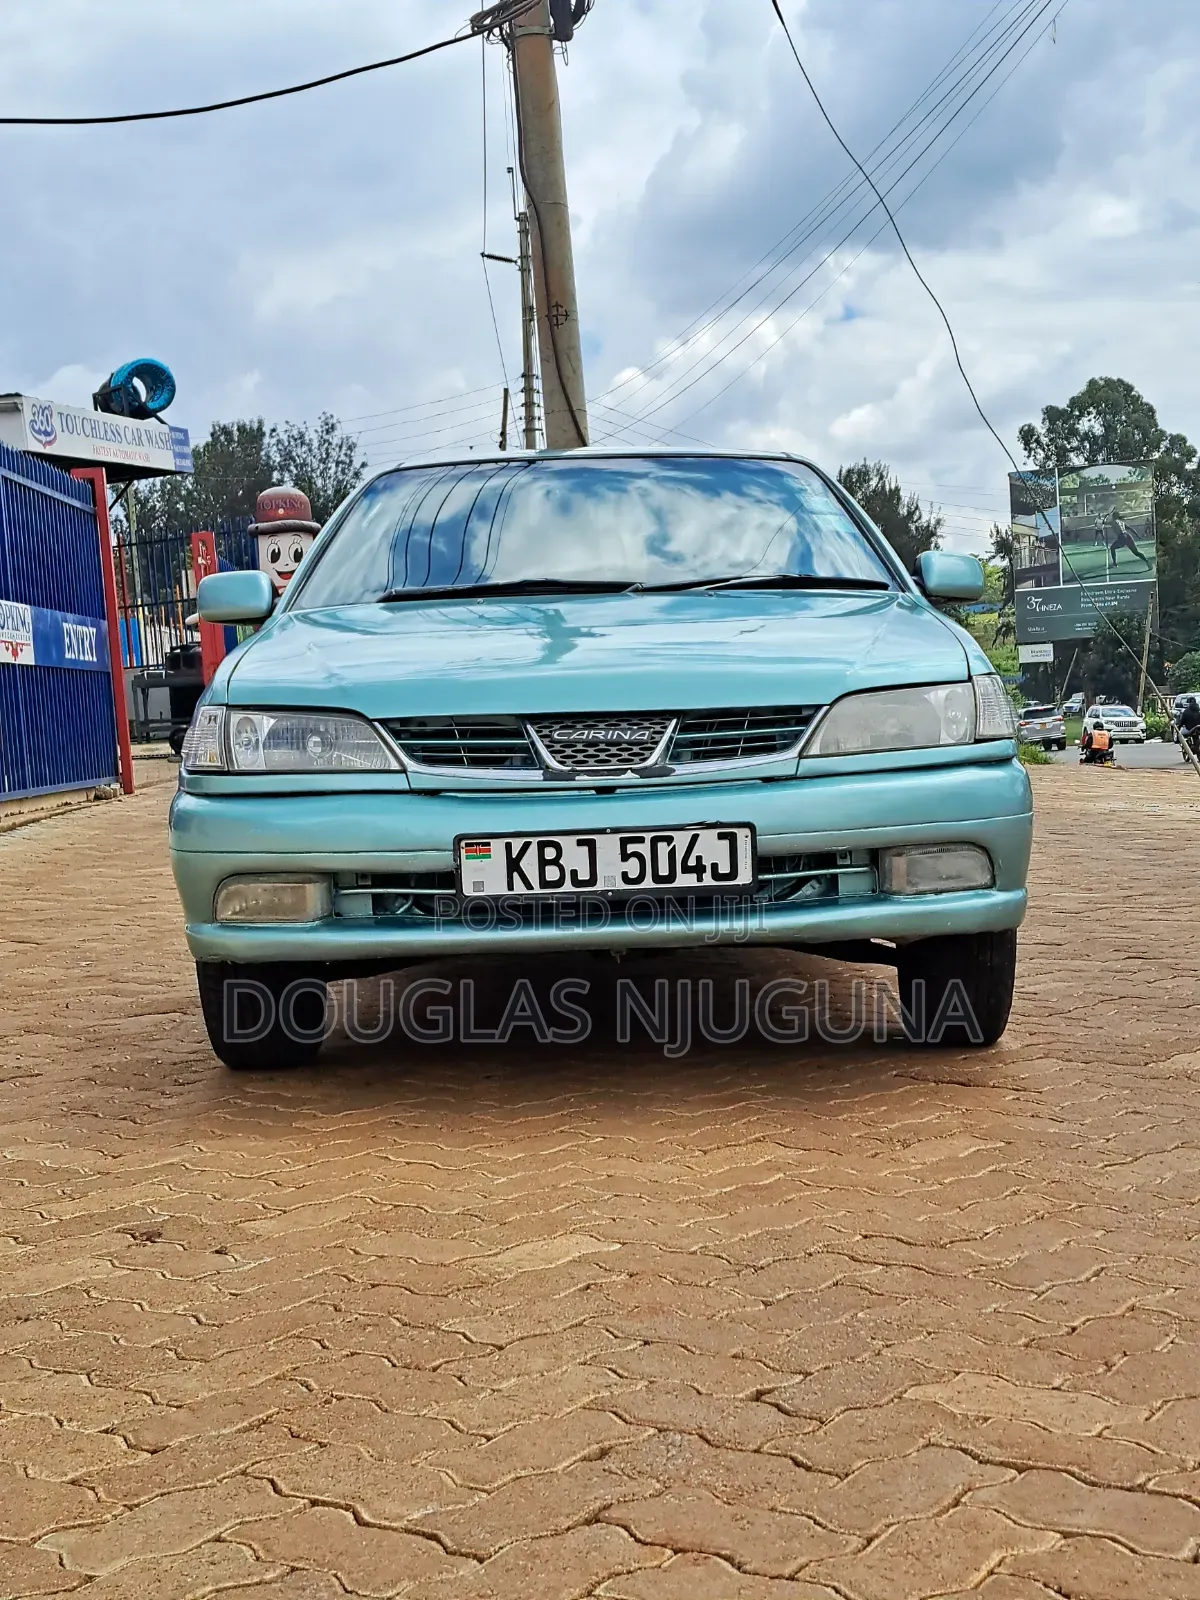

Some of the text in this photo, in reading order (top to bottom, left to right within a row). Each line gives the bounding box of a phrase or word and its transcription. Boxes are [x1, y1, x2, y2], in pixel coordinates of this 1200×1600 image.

[57, 411, 122, 444] TOUCHLESS
[124, 426, 144, 448] CAR
[145, 429, 172, 451] WASH
[1026, 595, 1043, 612] 37
[62, 621, 97, 662] ENTRY
[552, 729, 651, 741] CARINA
[504, 837, 598, 892] KBJ
[619, 831, 739, 886] 504J
